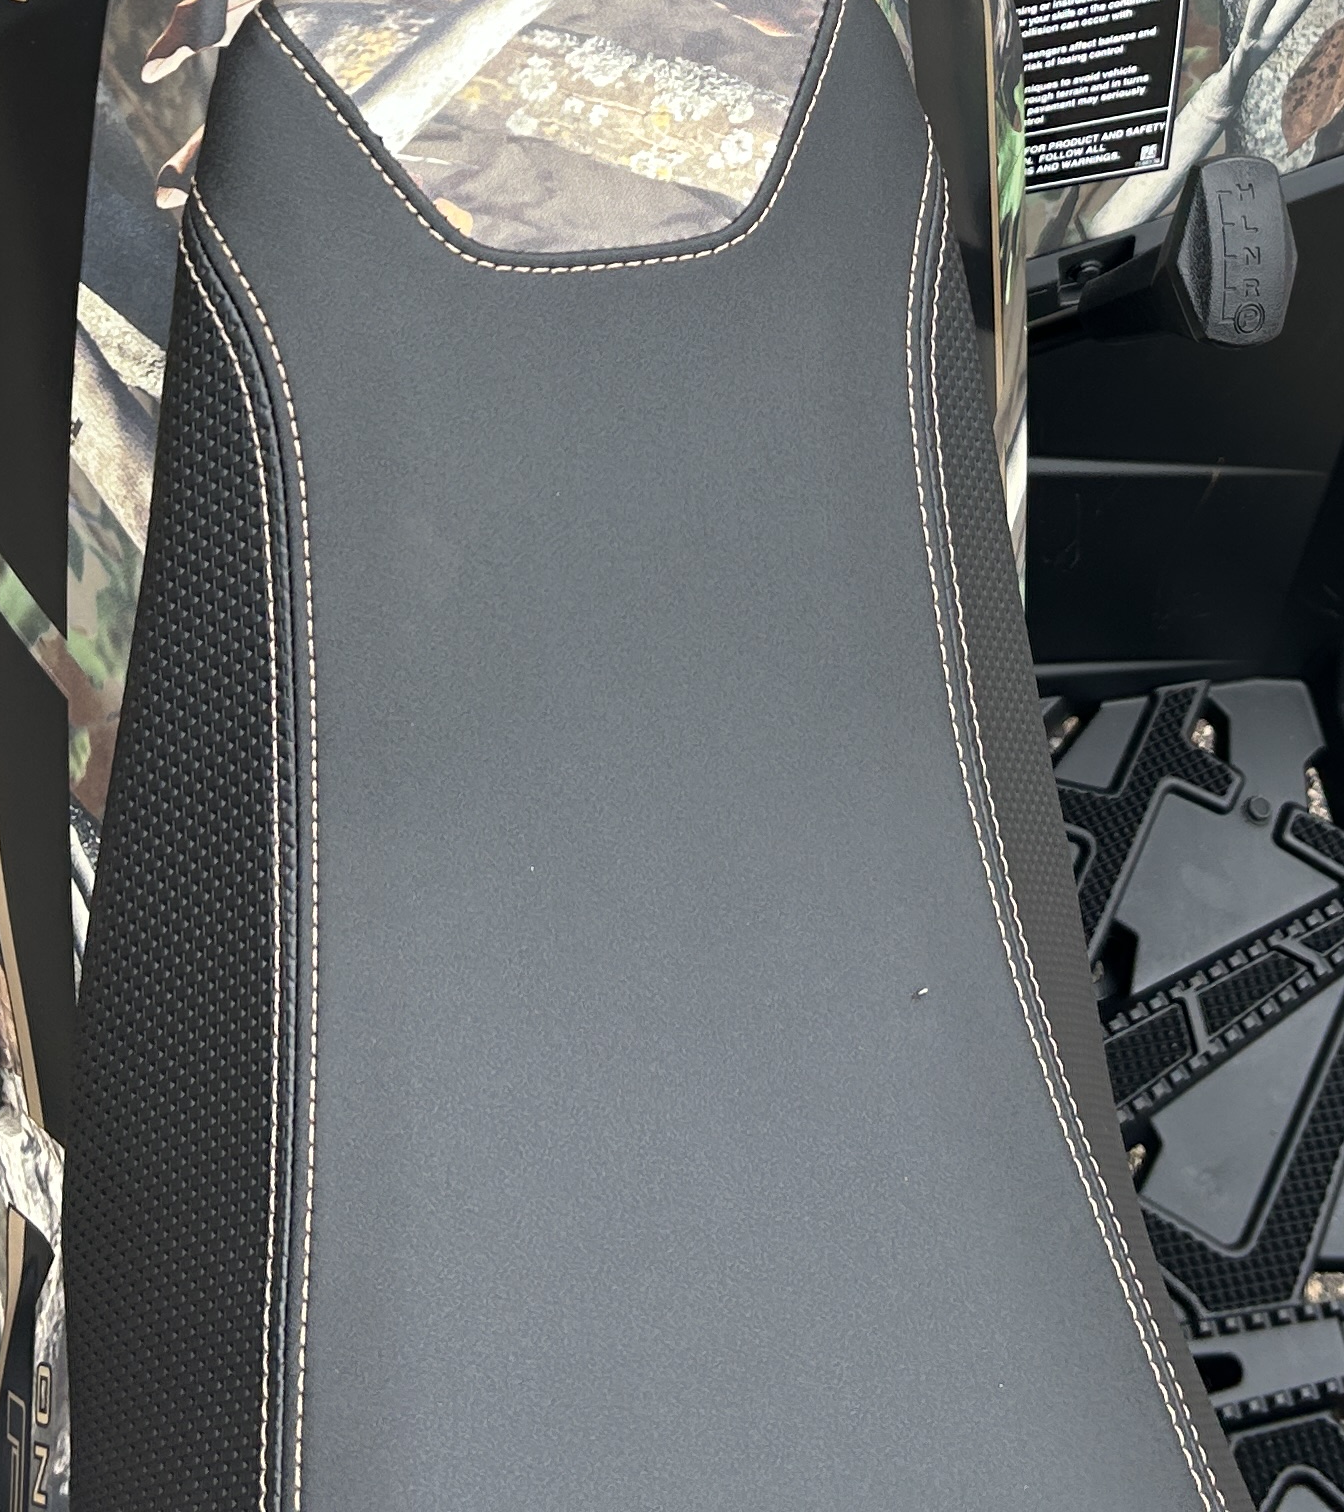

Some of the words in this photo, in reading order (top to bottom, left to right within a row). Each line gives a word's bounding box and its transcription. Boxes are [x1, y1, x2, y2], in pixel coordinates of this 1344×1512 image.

[1047, 133, 1099, 151] PRODUCT
[1100, 128, 1124, 141] AND
[1124, 121, 1166, 137] SAFETY
[1038, 147, 1084, 163] FOLLOW
[1085, 143, 1106, 154] ALL
[1035, 162, 1059, 173] AND
[1235, 182, 1256, 202] H
[1241, 214, 1259, 232] L
[1243, 245, 1262, 266] N
[1243, 277, 1261, 298] R
